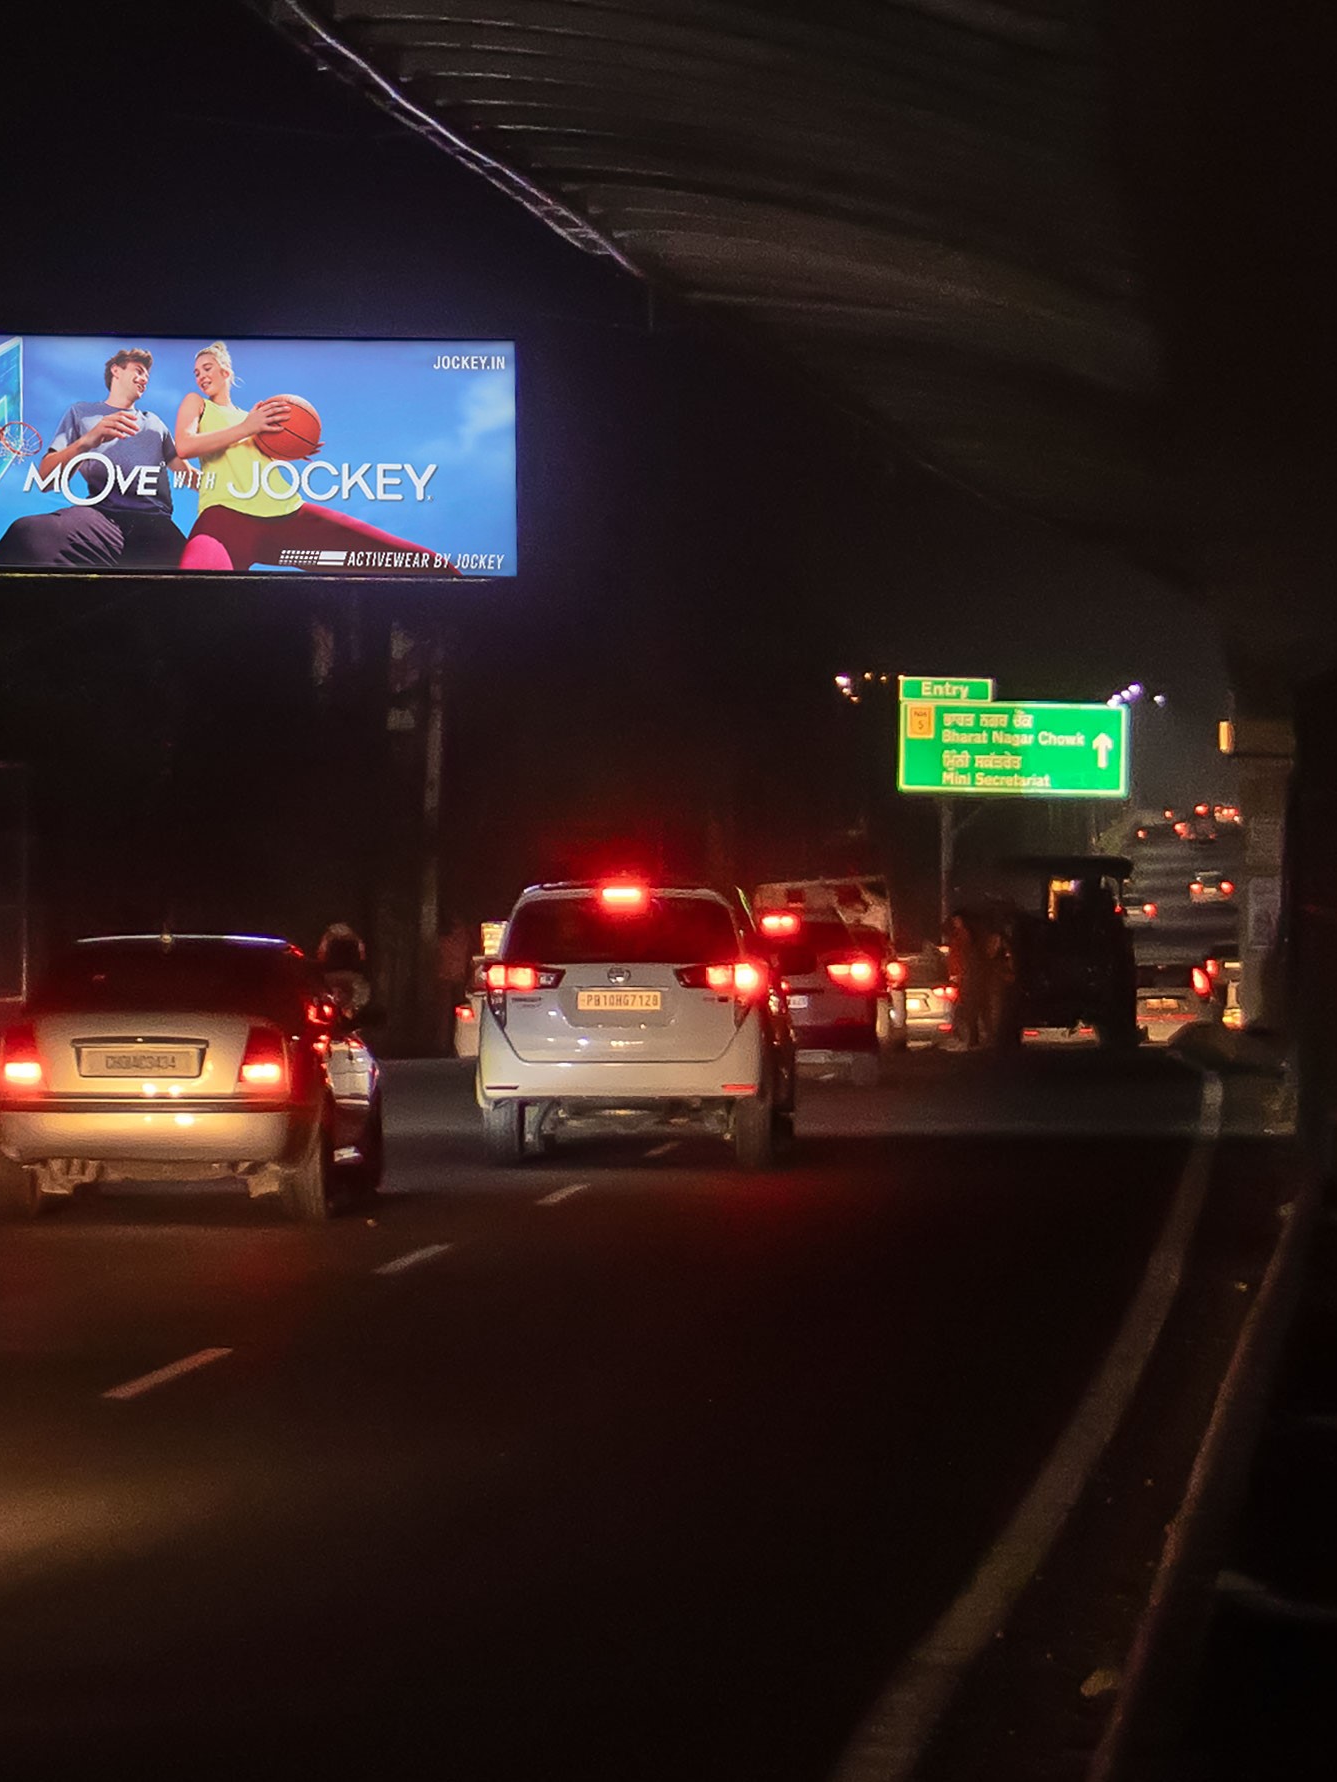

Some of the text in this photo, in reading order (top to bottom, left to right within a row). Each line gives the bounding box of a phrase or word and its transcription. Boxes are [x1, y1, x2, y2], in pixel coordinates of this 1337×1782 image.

[432, 355, 506, 370] JOCKEY.IN
[22, 451, 438, 507] MOVE WITH JOCKEY
[346, 551, 505, 570] ACTIVEWEAR BY JOCKEY
[921, 681, 969, 700] Entry
[942, 731, 1085, 747] Bharat Nagar Chowk
[942, 771, 1051, 788] Mini Secretariat
